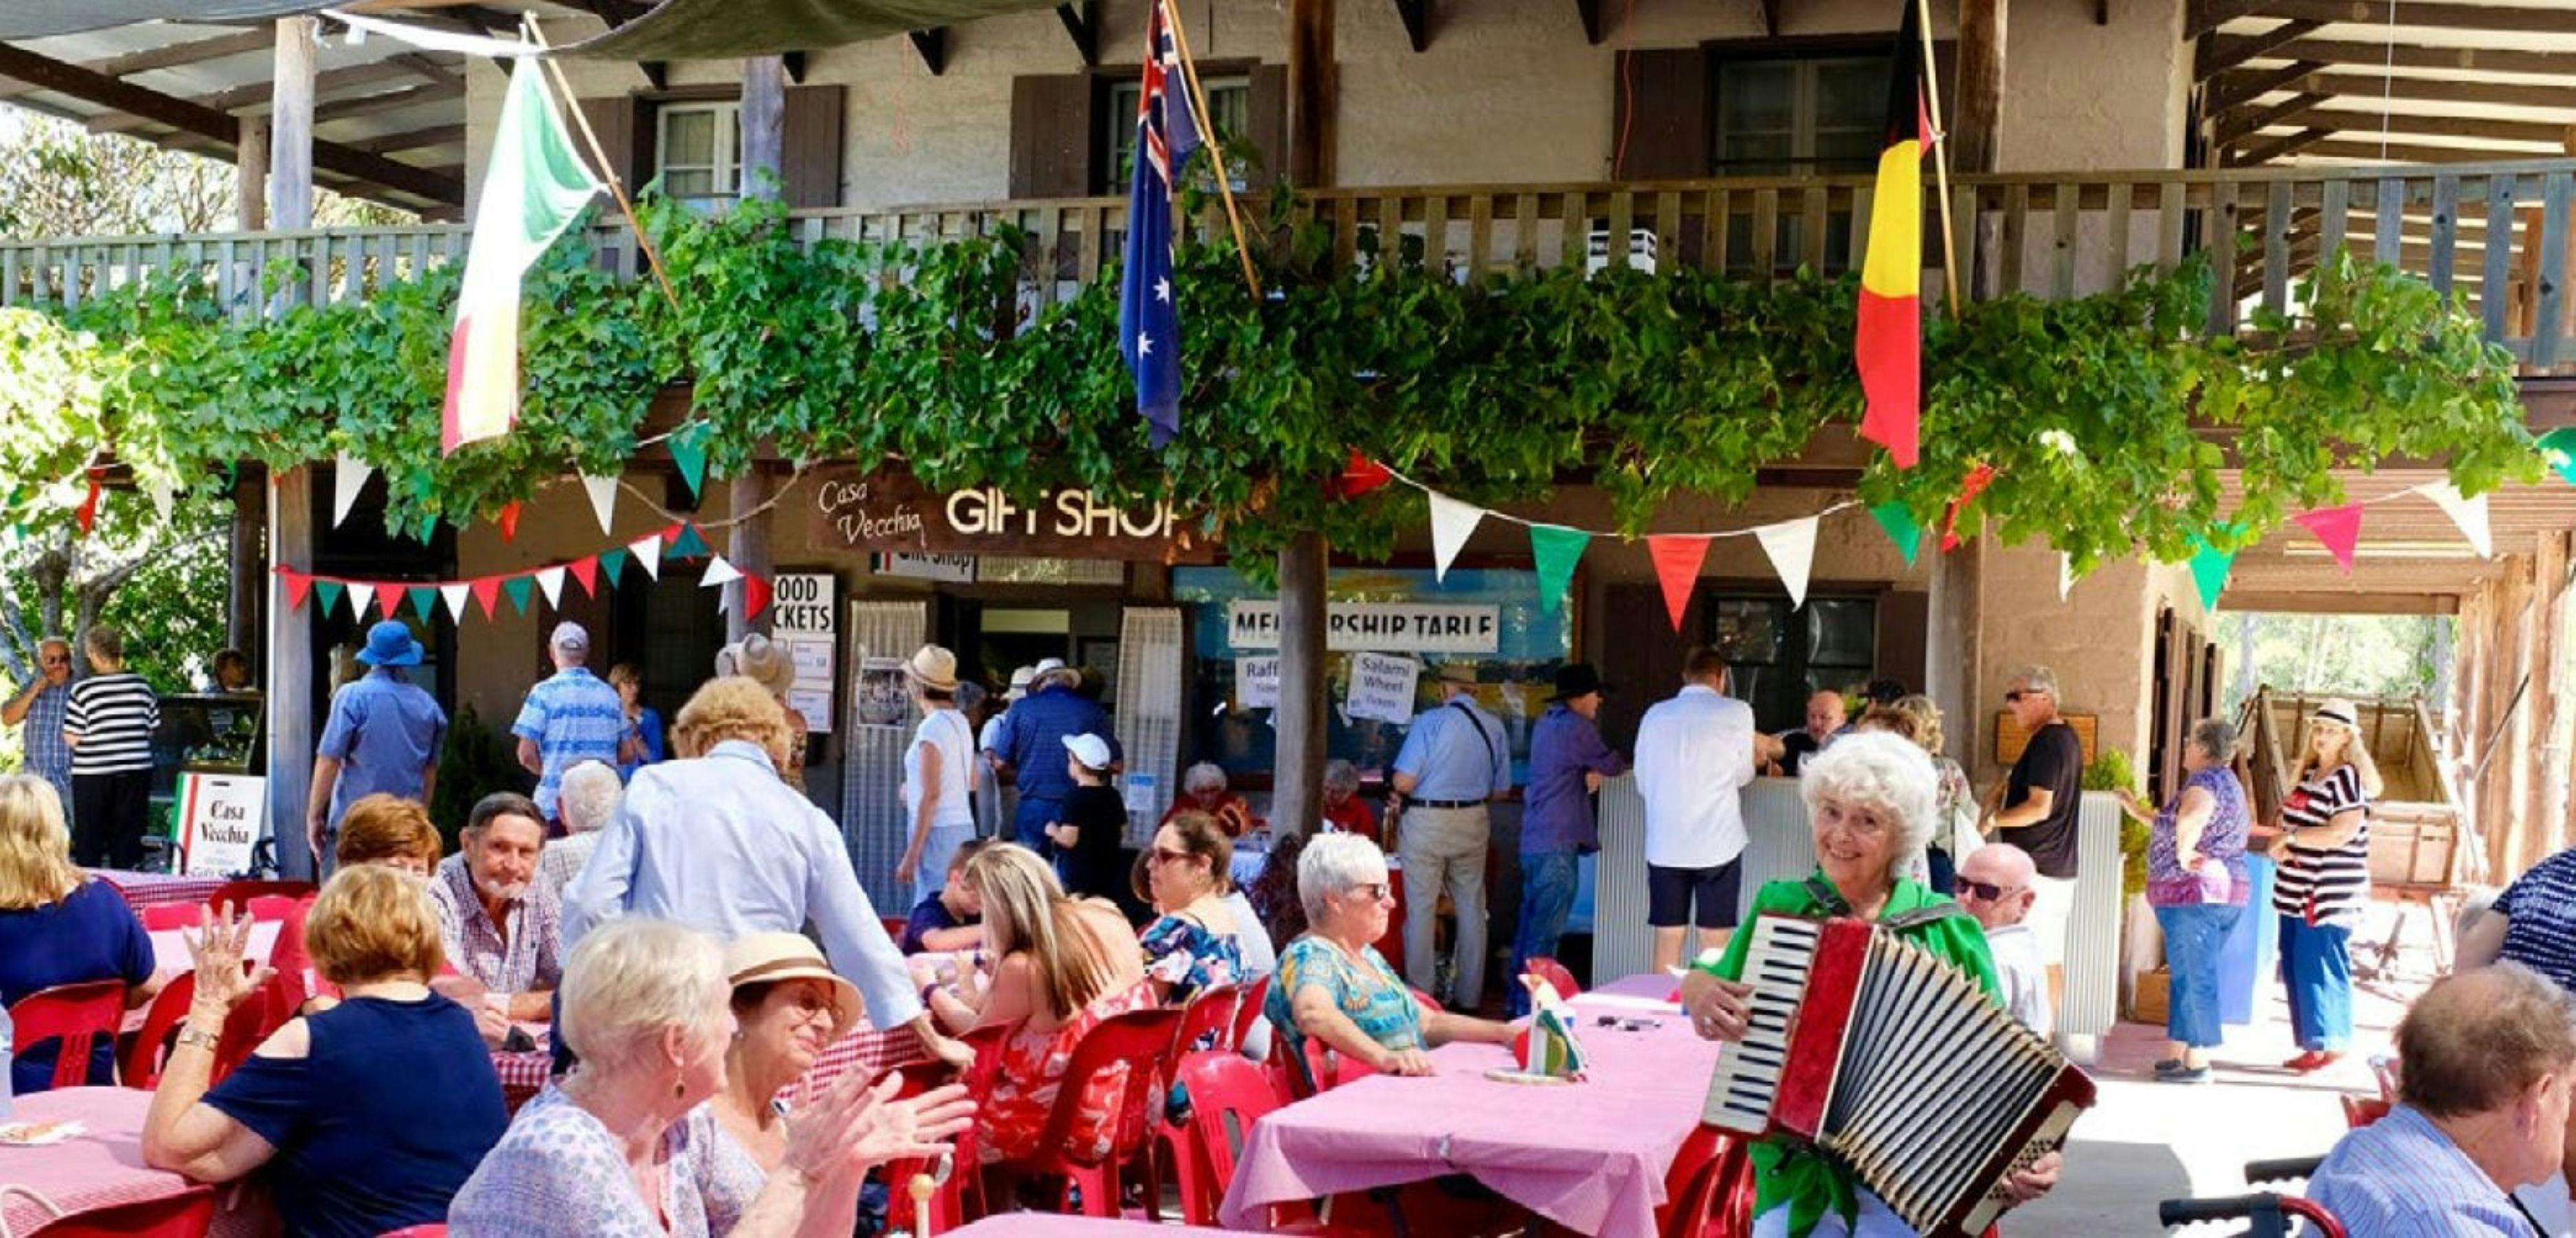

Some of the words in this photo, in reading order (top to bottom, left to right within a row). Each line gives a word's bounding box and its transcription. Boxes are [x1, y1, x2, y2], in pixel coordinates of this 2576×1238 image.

[818, 481, 868, 513] Casa
[946, 486, 1050, 535] GIFT
[837, 504, 927, 549] Vecchia
[777, 576, 818, 602] OOD
[774, 605, 831, 631] CKETS
[1236, 612, 1407, 636] MERSHIP
[1246, 659, 1278, 677] Raff
[1362, 657, 1410, 677] Salami
[210, 799, 245, 821] Casa
[202, 822, 249, 844] Vecchia
